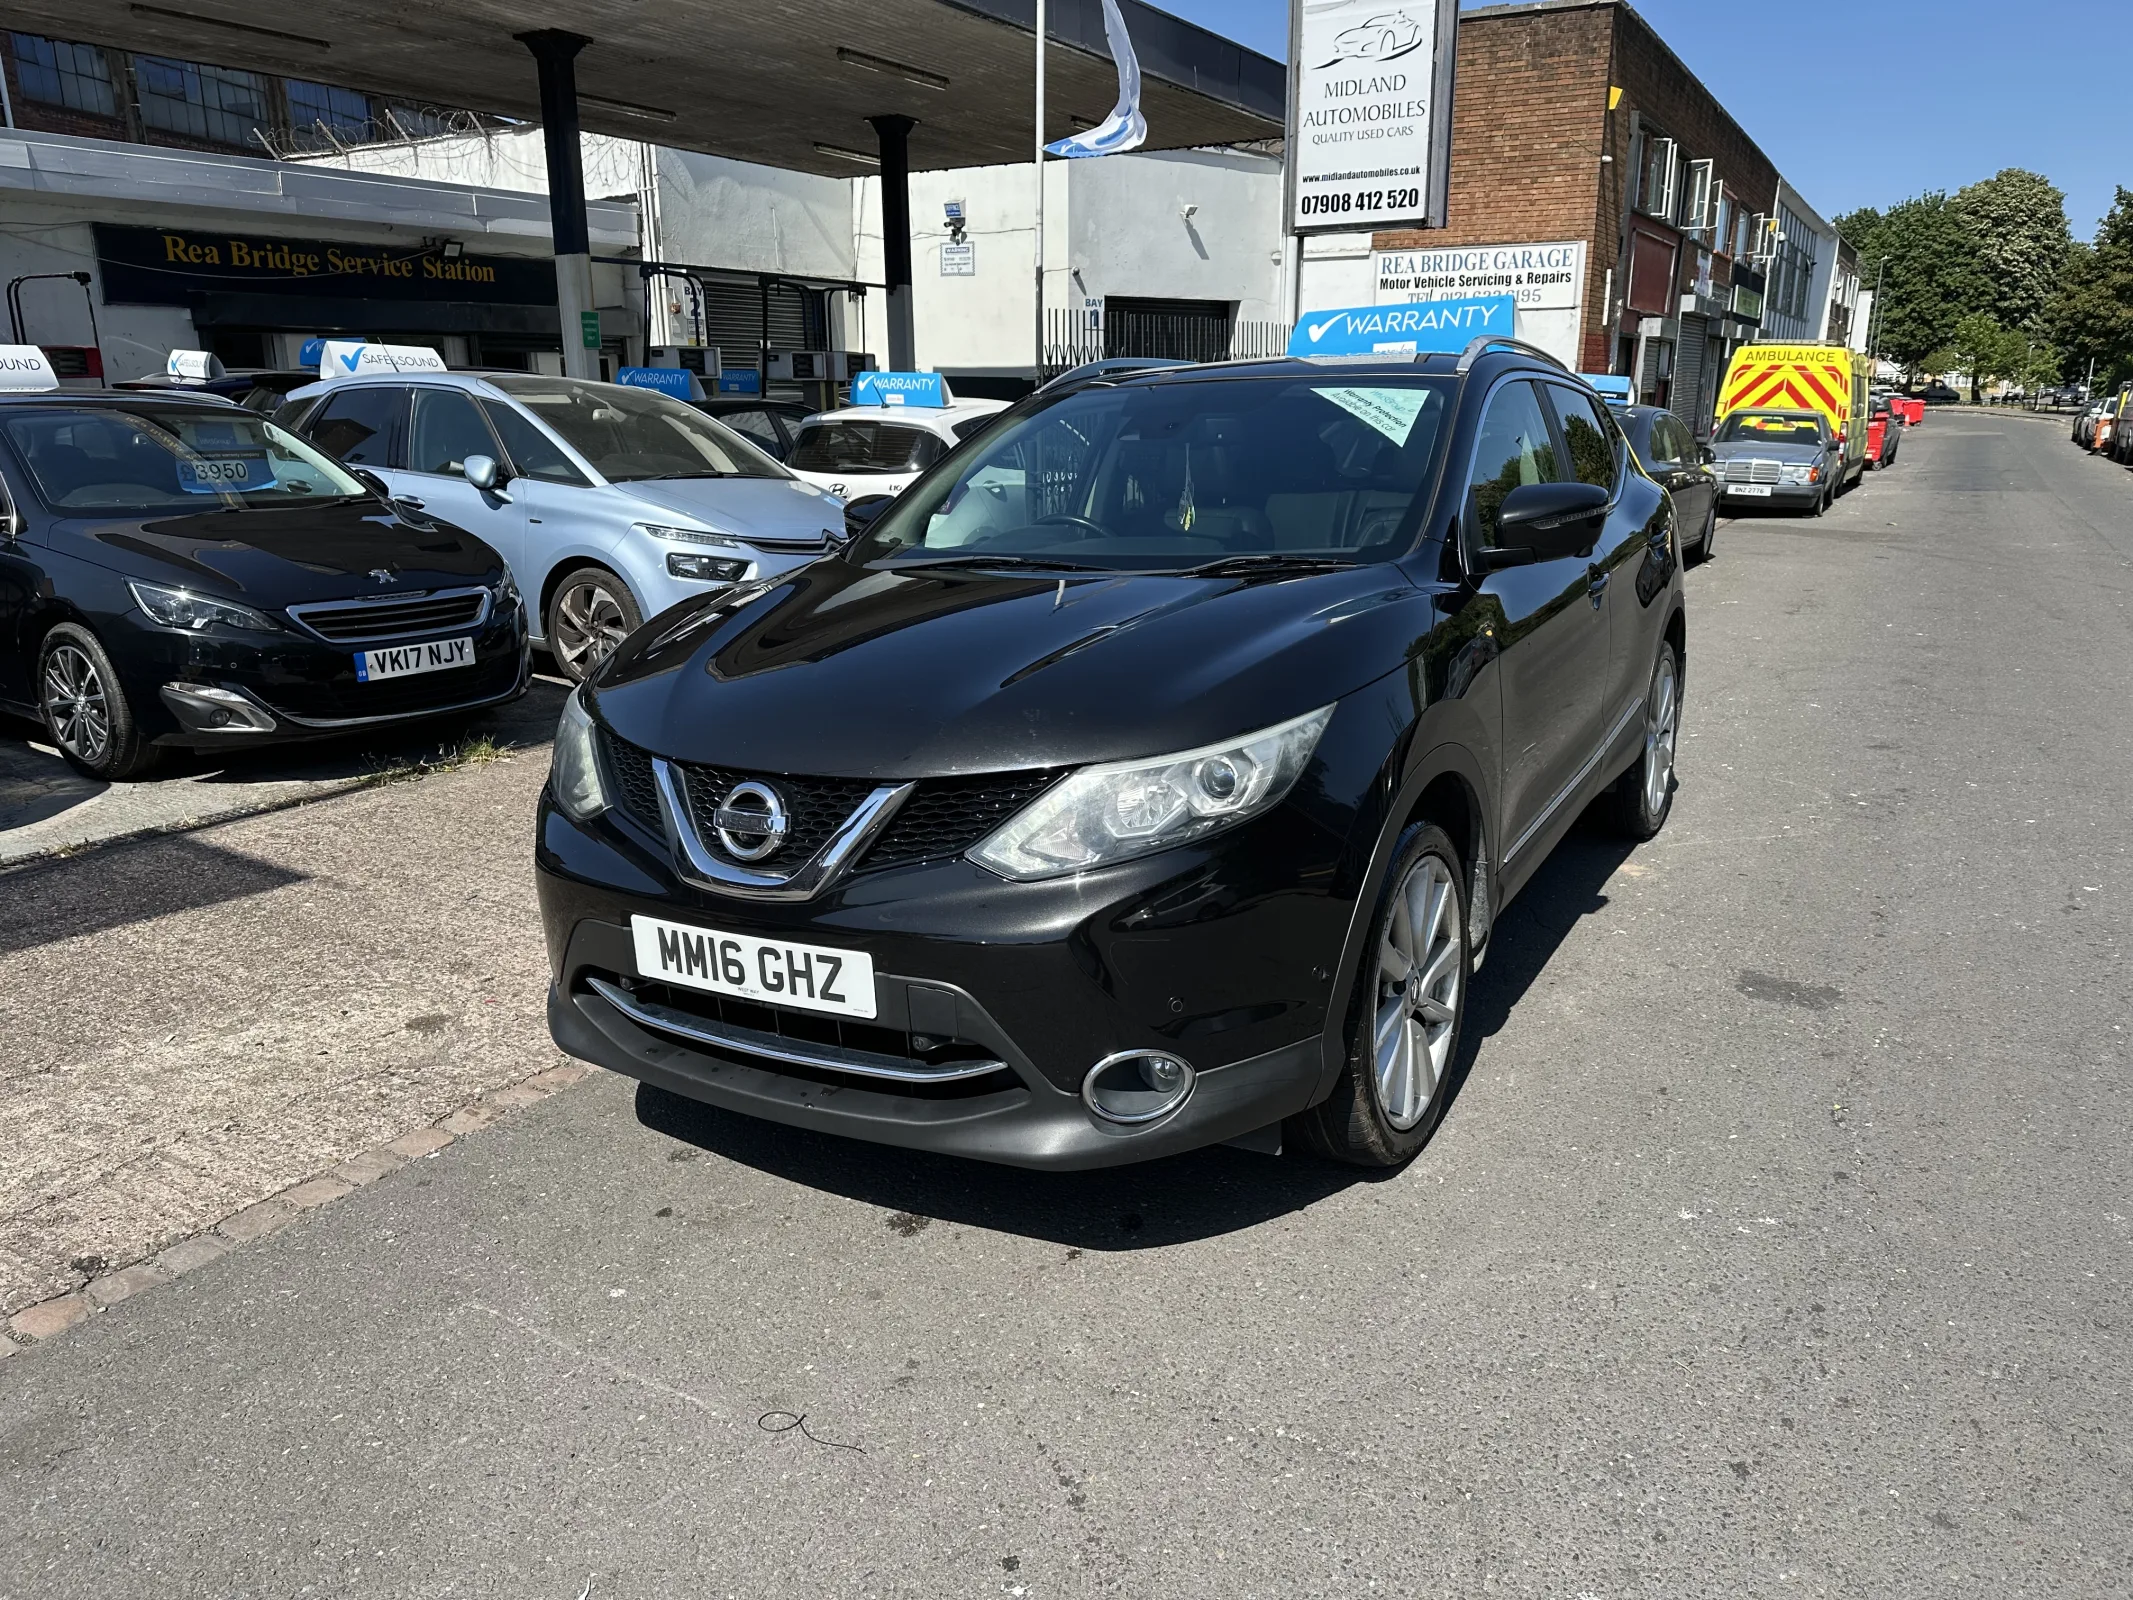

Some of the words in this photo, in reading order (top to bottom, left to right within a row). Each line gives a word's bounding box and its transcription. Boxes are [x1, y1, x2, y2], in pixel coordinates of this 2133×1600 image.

[1324, 74, 1406, 98] MIDLAND
[1303, 100, 1426, 127] AUTOMOBILES
[1312, 131, 1354, 145] QUALITY
[1357, 128, 1384, 140] USED
[1387, 125, 1414, 137] CARS
[1302, 166, 1420, 183] www.midlandautomobiles.co.uk
[1301, 193, 1351, 215] 07908
[1355, 191, 1383, 210] 412
[1387, 188, 1419, 209] 520
[162, 235, 220, 264] Rea
[229, 240, 320, 276] Bridge
[327, 249, 413, 277] Service
[423, 255, 495, 283] Station
[1381, 255, 1416, 274] REA
[1421, 252, 1489, 272] BRIDGE
[1494, 248, 1573, 270] GARAGE
[1380, 277, 1411, 290] Motor
[1414, 275, 1455, 288] Vehicle
[1459, 273, 1512, 287] Servicing
[1516, 274, 1523, 284] &
[1527, 271, 1572, 285] Repairs
[1085, 299, 1103, 307] BAY
[1346, 304, 1499, 335] WARRANTY
[1745, 351, 1835, 362] AMBULANCE
[634, 372, 685, 385] WARRANTY
[873, 377, 935, 391] WARRANTY
[1344, 389, 1372, 406] Warranty
[1372, 405, 1406, 428] Protection
[374, 647, 422, 673] VK17
[427, 640, 465, 666] NJY
[657, 926, 746, 986] MM16
[757, 946, 846, 1003] GHZ
